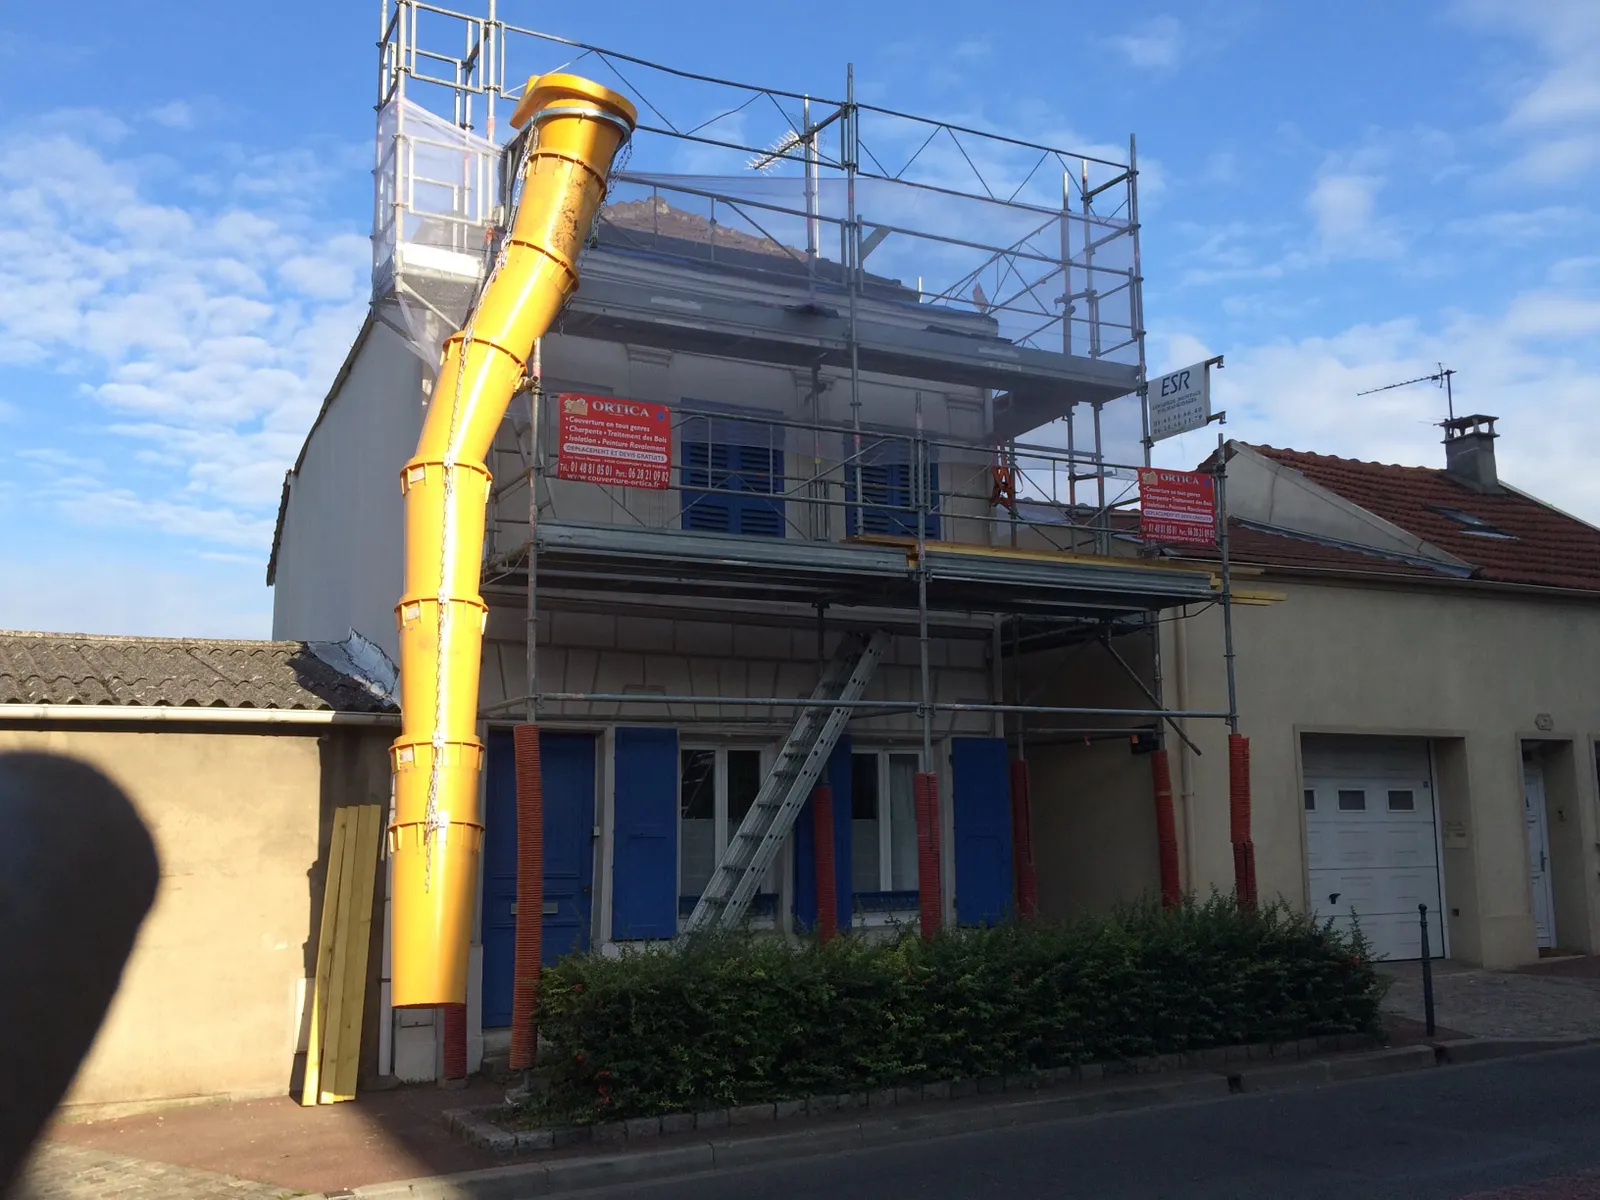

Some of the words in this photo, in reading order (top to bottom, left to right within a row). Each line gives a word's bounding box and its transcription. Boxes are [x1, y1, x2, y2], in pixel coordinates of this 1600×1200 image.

[1161, 370, 1190, 398] ESR
[592, 401, 649, 417] ORTICA
[569, 416, 604, 427] Couverture
[616, 422, 629, 430] tous
[630, 424, 650, 432] genres
[569, 425, 603, 436] Charpente
[607, 430, 641, 440] Traitement
[642, 433, 652, 441] des
[654, 435, 667, 443] Bois
[569, 434, 597, 444] Isolation
[602, 438, 628, 448] Peinture
[629, 441, 666, 452] Ravalement
[619, 450, 636, 458] DEVIS
[637, 452, 665, 461] GRATUITS
[567, 473, 661, 488] www.couverture-ortica.fr
[1160, 474, 1199, 485] ORTICA
